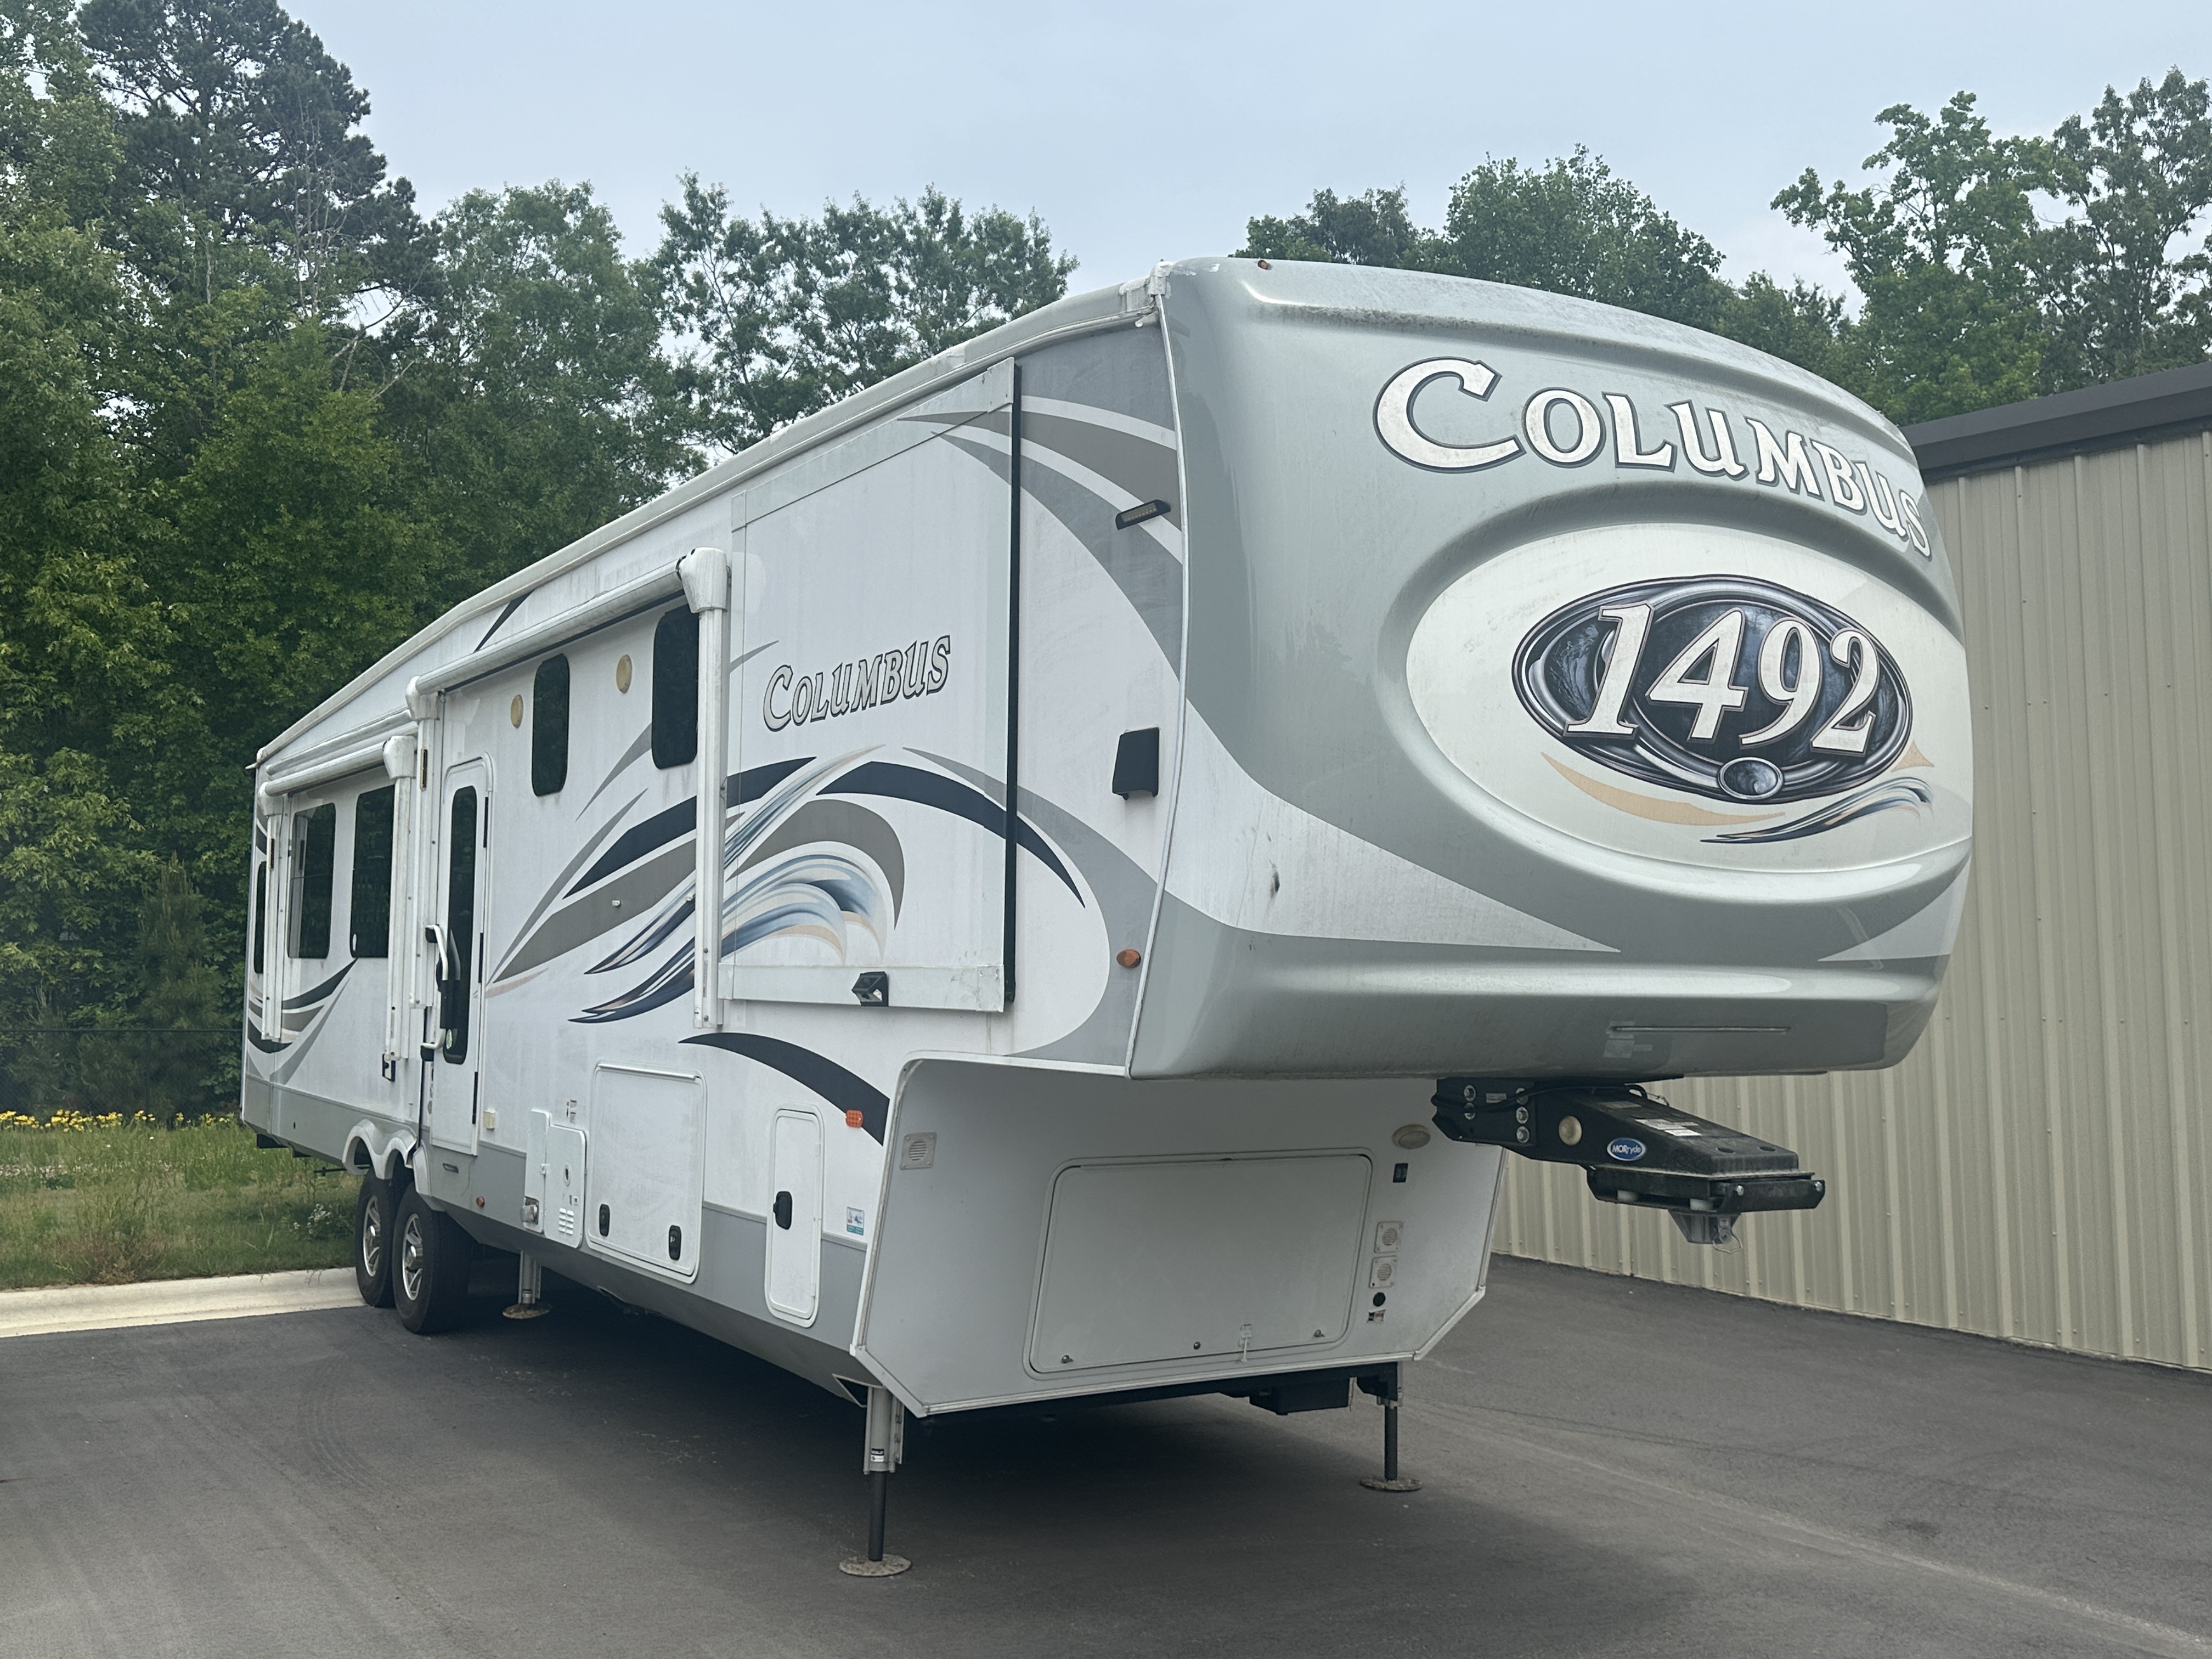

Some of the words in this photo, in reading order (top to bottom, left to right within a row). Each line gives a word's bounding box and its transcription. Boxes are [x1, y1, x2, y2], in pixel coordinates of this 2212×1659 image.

[1373, 357, 1932, 560] COLUMBUS
[763, 635, 951, 732] COLUMBUS
[1564, 602, 1880, 757] 1492
